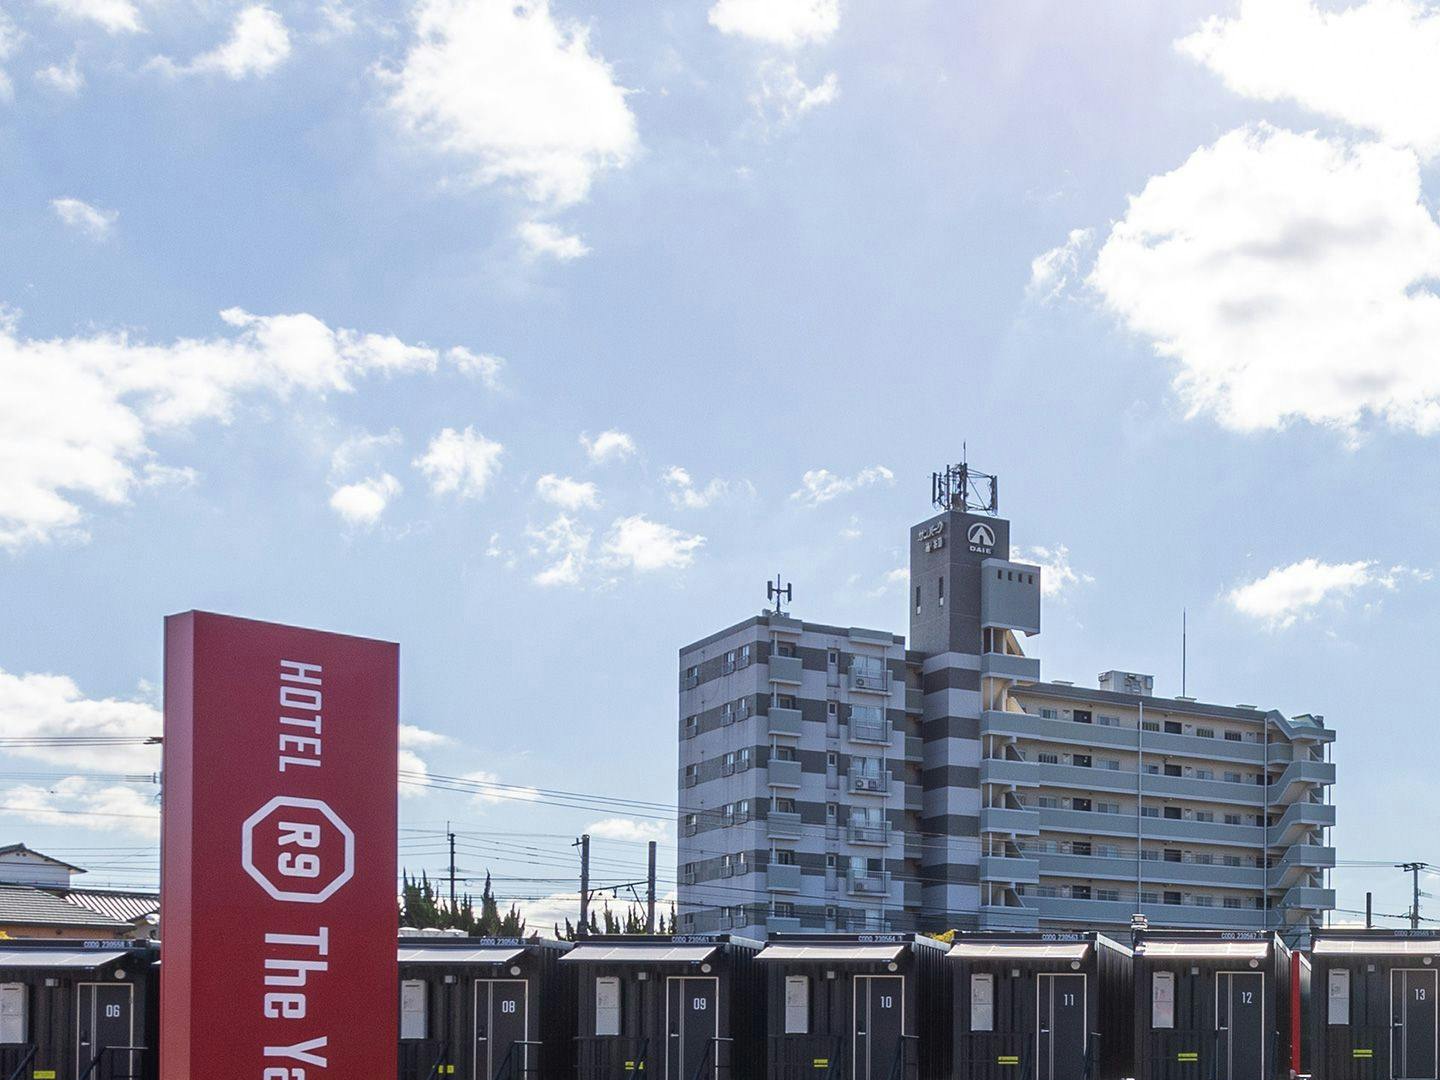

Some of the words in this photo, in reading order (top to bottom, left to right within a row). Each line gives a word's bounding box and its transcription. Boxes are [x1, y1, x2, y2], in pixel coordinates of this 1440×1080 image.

[278, 658, 323, 772] HOTEL
[277, 821, 320, 878] R9
[264, 926, 329, 1019] The
[1064, 994, 1074, 1006] 11
[1242, 992, 1253, 1004] 12
[1415, 989, 1426, 1001] 13
[502, 1000, 515, 1013] 08
[694, 998, 706, 1010] 09
[881, 996, 892, 1008] 10
[106, 1004, 120, 1018] 06
